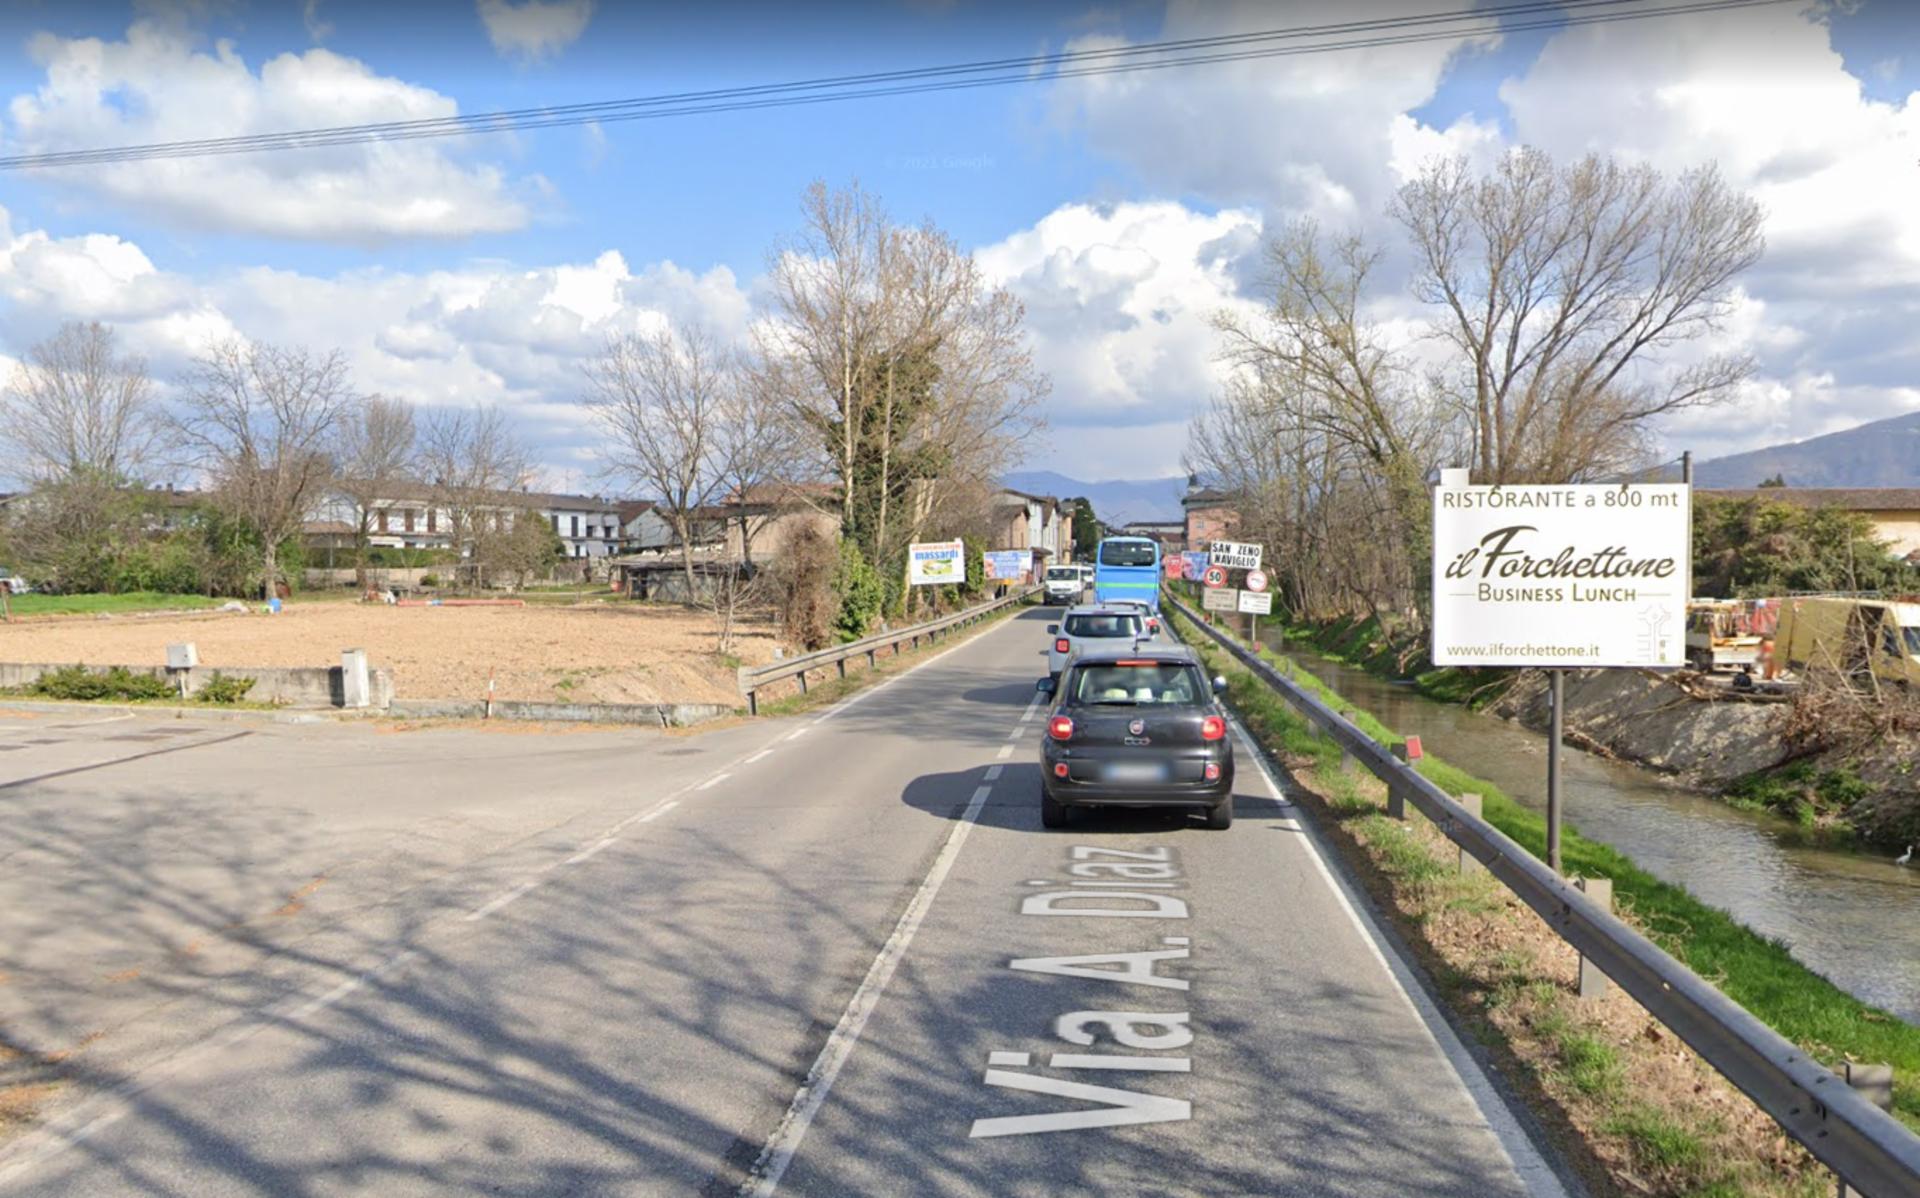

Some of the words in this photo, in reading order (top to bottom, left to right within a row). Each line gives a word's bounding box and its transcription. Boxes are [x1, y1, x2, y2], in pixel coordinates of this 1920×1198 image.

[1443, 491, 1576, 508] RISTORANTE
[1584, 494, 1596, 507] a
[1604, 490, 1642, 507] 800
[1651, 492, 1679, 507] mt
[915, 549, 959, 560] massardi
[1212, 543, 1232, 554] SAN
[1238, 546, 1260, 557] ZENO
[1445, 547, 1480, 579] il
[1480, 525, 1676, 579] Forchettone
[1214, 554, 1257, 567] NAVIGLIO
[1209, 571, 1222, 582] 50
[1446, 643, 1600, 658] www.ilforchettone.it
